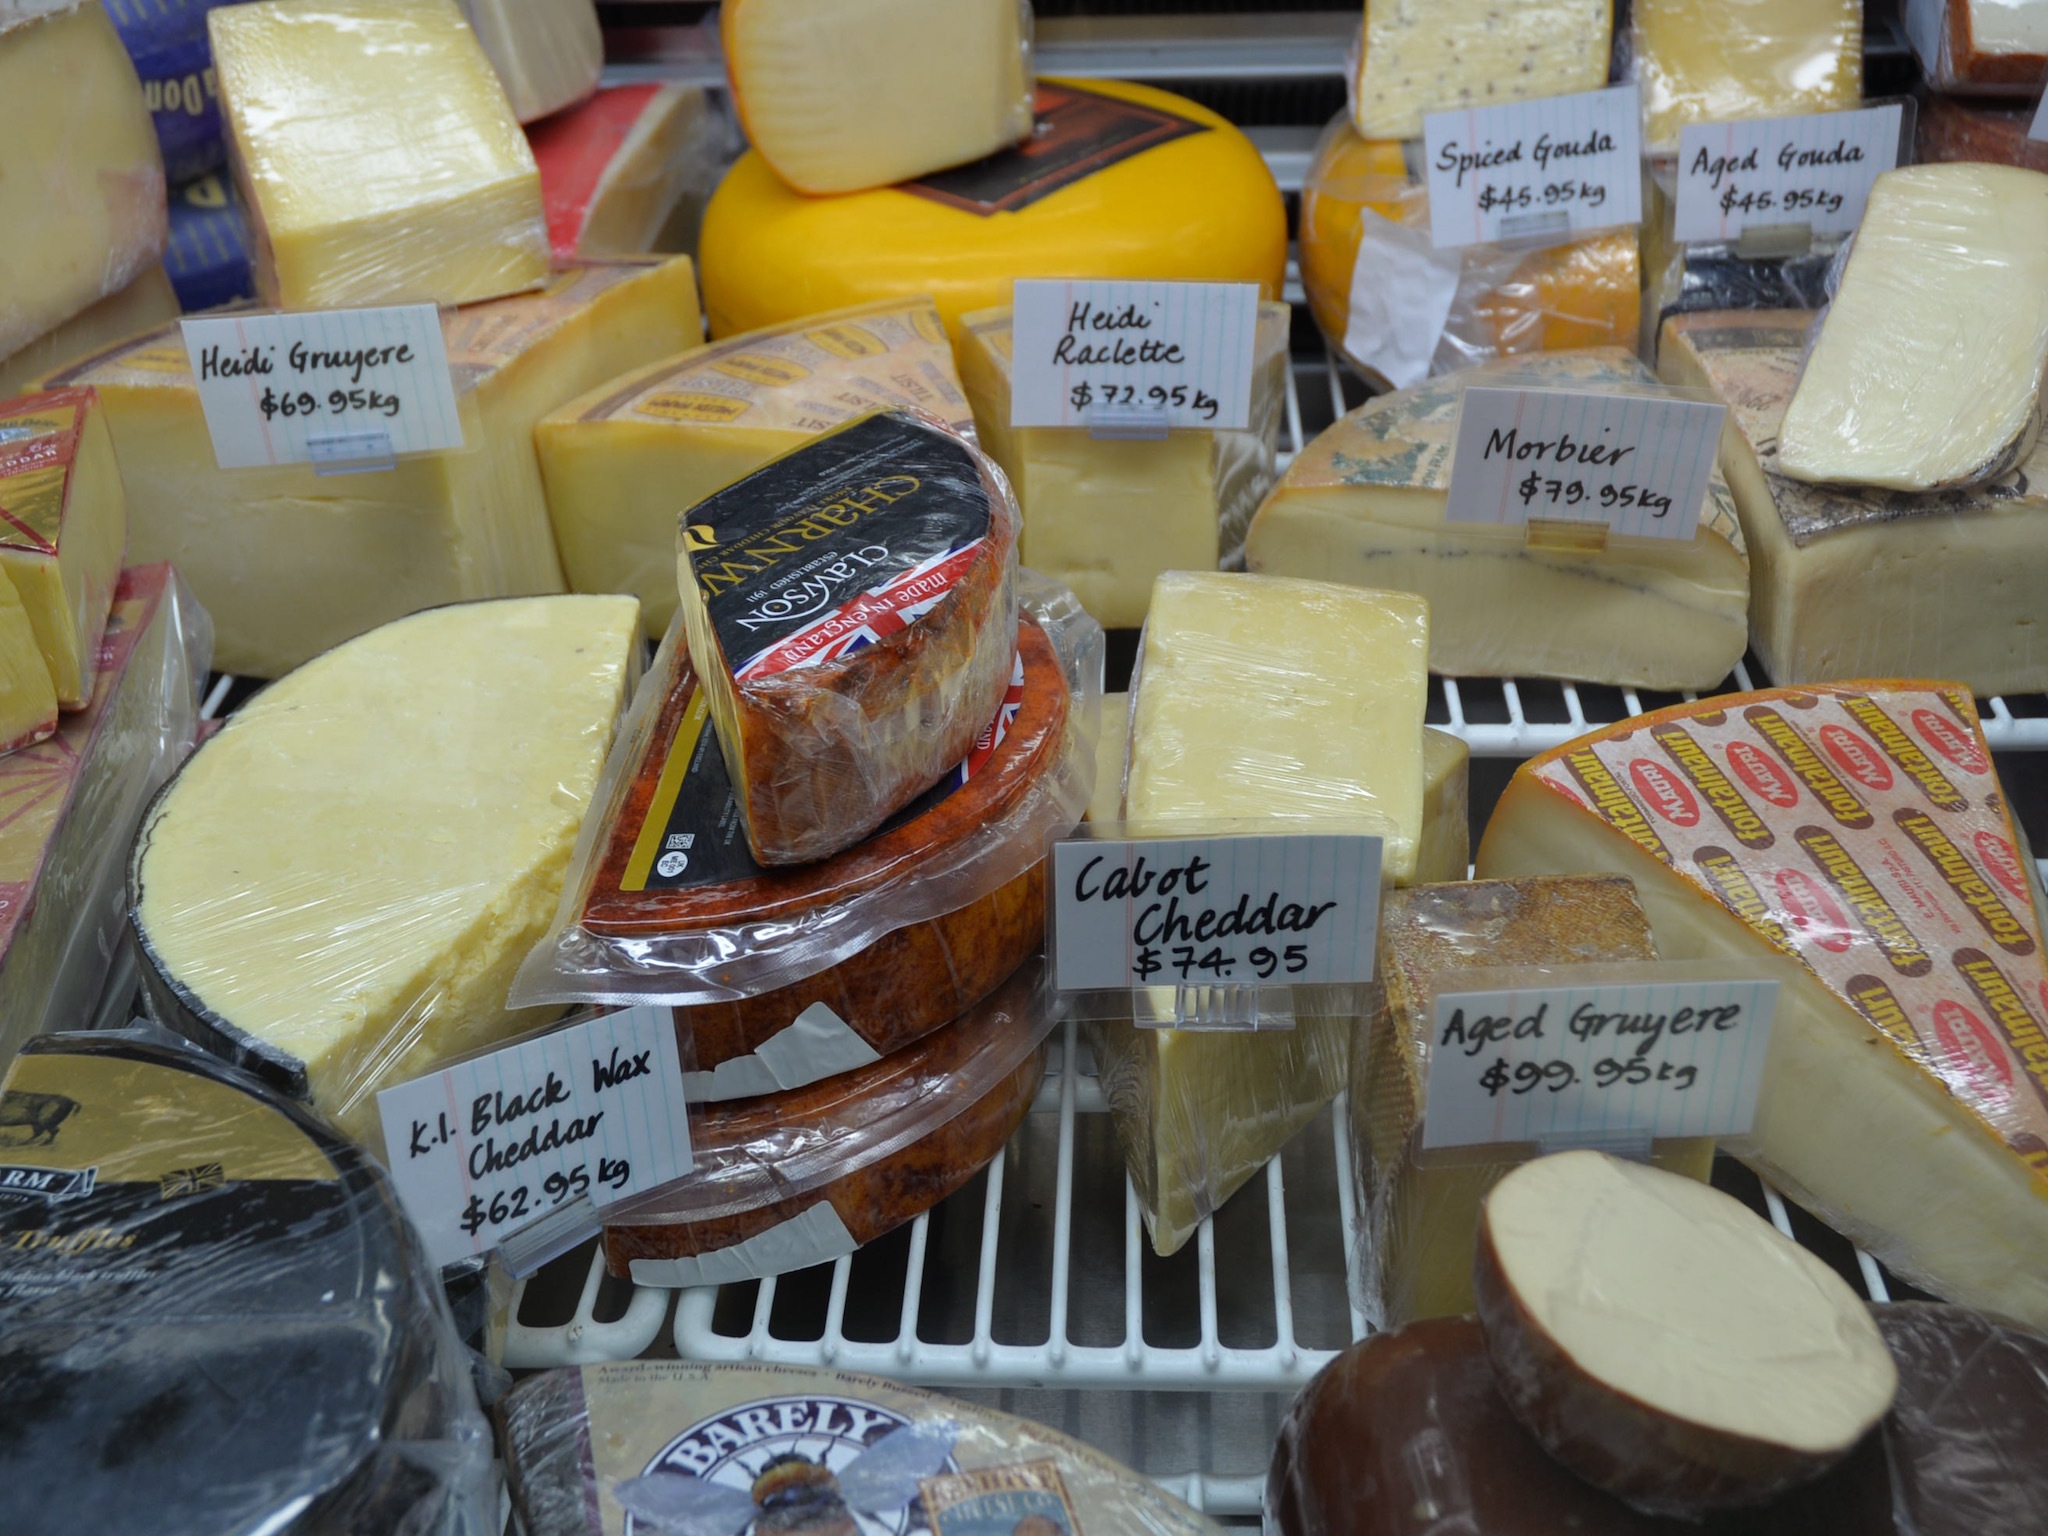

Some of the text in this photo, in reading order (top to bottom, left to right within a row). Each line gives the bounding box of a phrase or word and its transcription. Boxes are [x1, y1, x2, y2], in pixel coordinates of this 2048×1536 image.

[1436, 129, 1617, 188] Spiced Gouda
[1691, 139, 1864, 190] Aged Gouda
[1067, 301, 1160, 333] Heidi
[201, 344, 275, 381] Heidi
[288, 340, 416, 384] Gruyere
[1052, 333, 1185, 366] Raclette
[1483, 425, 1636, 467] Morbier
[745, 587, 767, 603] 1911
[870, 596, 894, 614] IN
[1731, 745, 1793, 798] MAURI
[1749, 710, 1869, 822] fontalmauri
[1826, 729, 1889, 782] MAURI
[1842, 697, 1962, 804] fontalmauri
[1567, 745, 1669, 858] ontalmaur
[1635, 761, 1695, 818] MAURI
[1656, 729, 1769, 840] fontalmauri
[676, 859, 685, 867] UK
[1075, 855, 1211, 903] Cabot
[1897, 814, 2029, 943] fontalmauri
[1133, 891, 1338, 947] Cheddar
[1132, 944, 1308, 982] $74.95
[1441, 1002, 1741, 1057] Aged Gruyere
[470, 1071, 571, 1137] Black
[591, 1046, 651, 1094] Wax
[468, 1110, 605, 1181] Cheddar
[2, 1170, 53, 1190] RM
[13, 1228, 138, 1257] Truffles
[835, 1372, 879, 1389] Barely
[665, 1400, 894, 1477] BARELY
